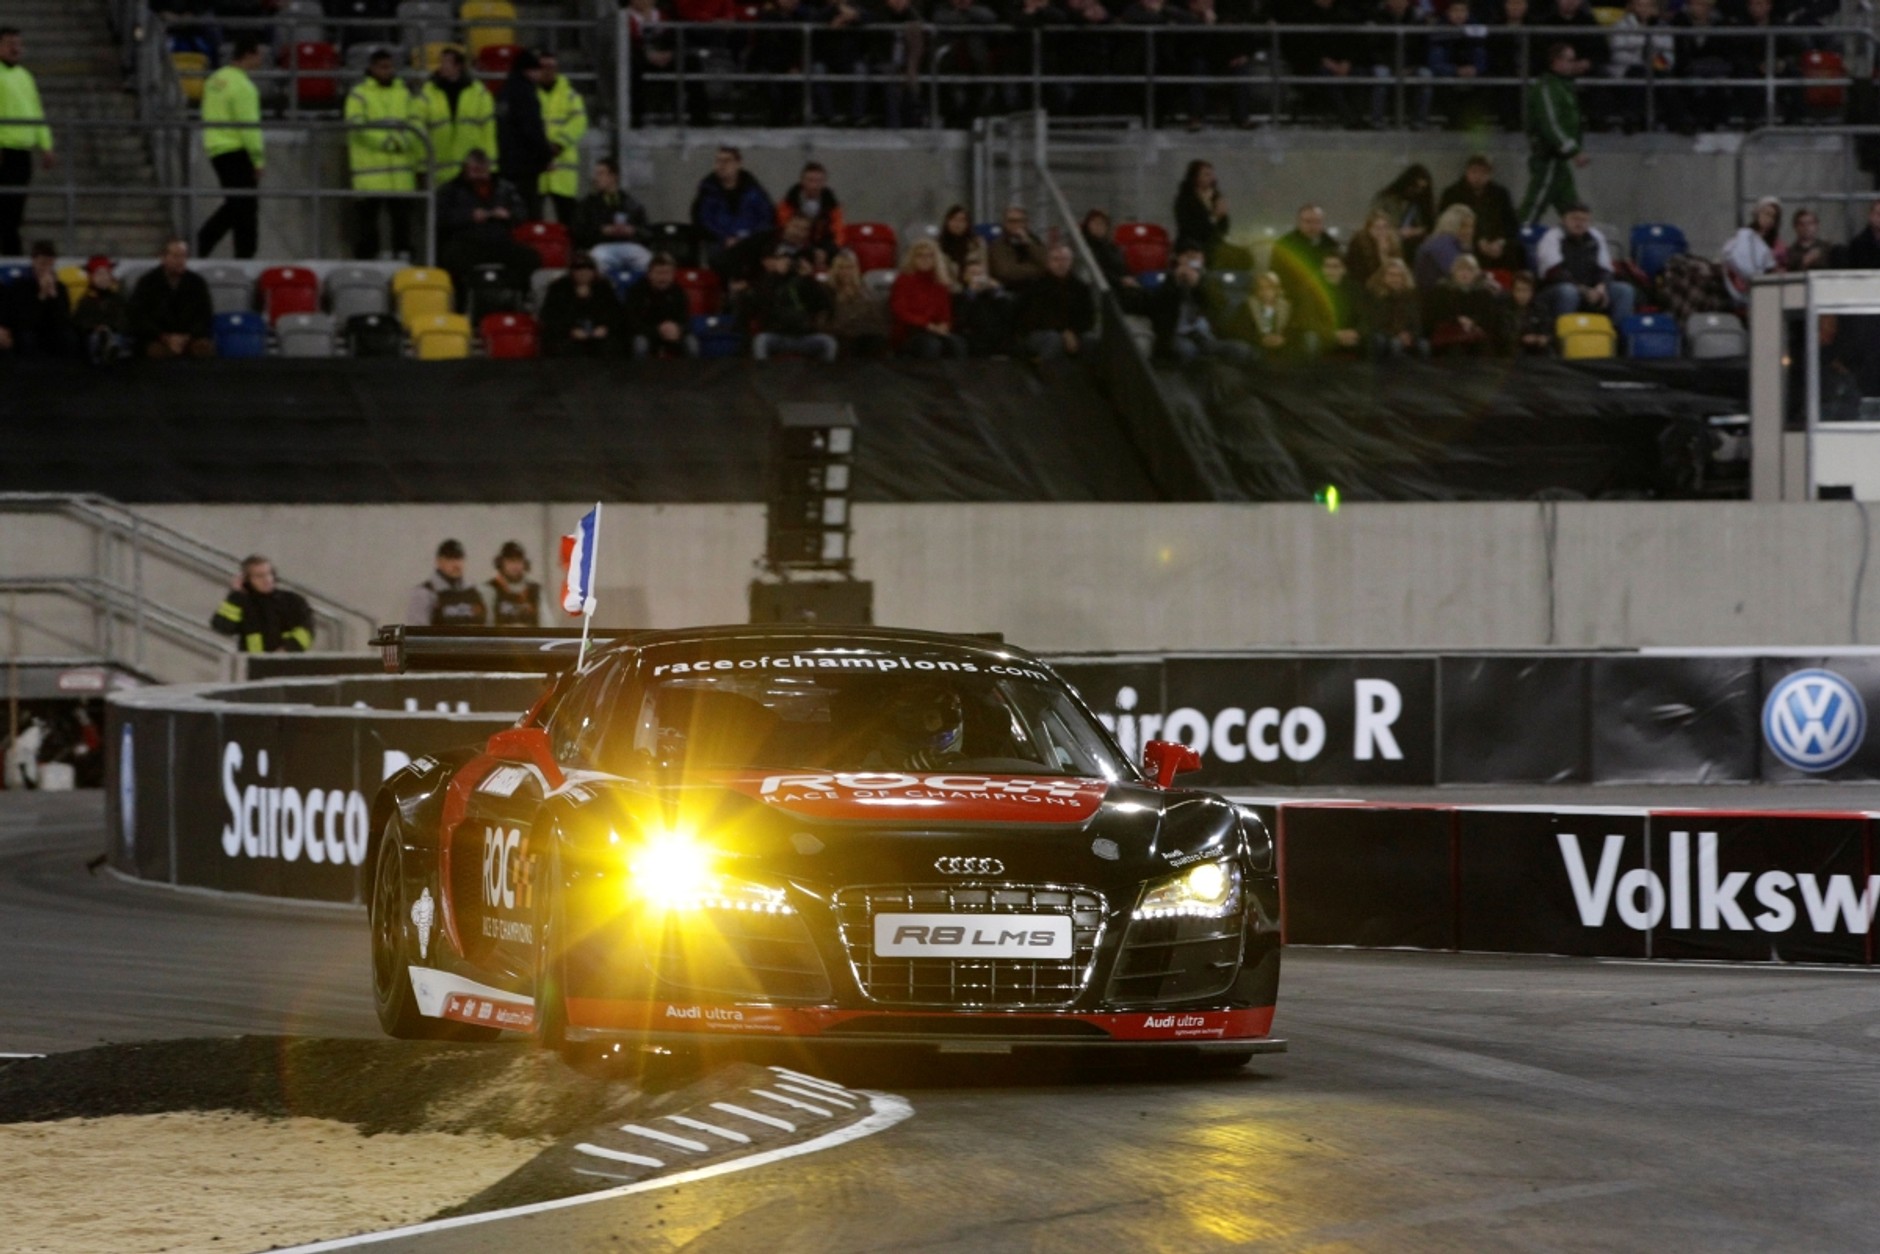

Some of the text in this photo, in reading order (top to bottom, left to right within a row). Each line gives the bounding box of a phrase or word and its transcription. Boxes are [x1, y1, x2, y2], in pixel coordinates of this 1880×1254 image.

[1354, 678, 1404, 761] R
[760, 772, 991, 795] ROC
[222, 741, 370, 866] Scirocco
[763, 789, 1082, 807] RACE OF CHAMPIONS
[483, 826, 521, 909] ROC
[1556, 831, 1880, 934] Volksw
[892, 926, 1056, 946] R8 LMS
[666, 1004, 744, 1021] Audi ultra
[1144, 1014, 1205, 1028] Audi ultra
